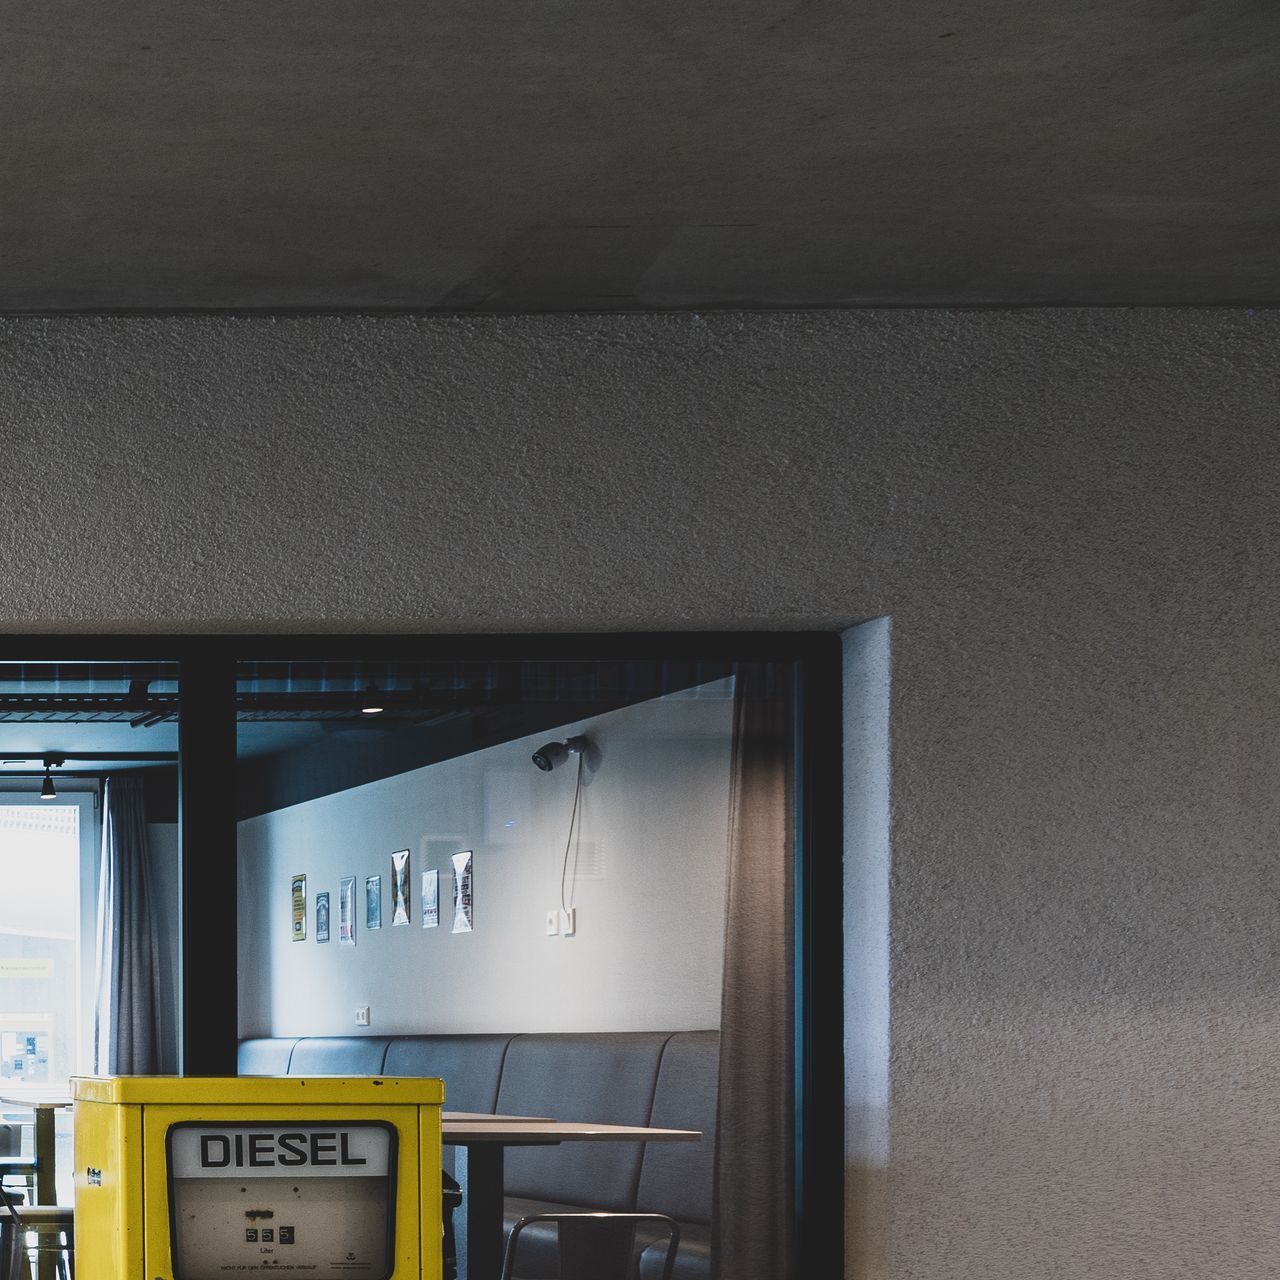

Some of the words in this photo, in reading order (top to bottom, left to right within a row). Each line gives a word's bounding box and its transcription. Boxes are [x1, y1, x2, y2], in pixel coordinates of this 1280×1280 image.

[200, 1132, 367, 1168] DIESEL
[247, 1230, 256, 1240] 5
[263, 1230, 272, 1240] 5
